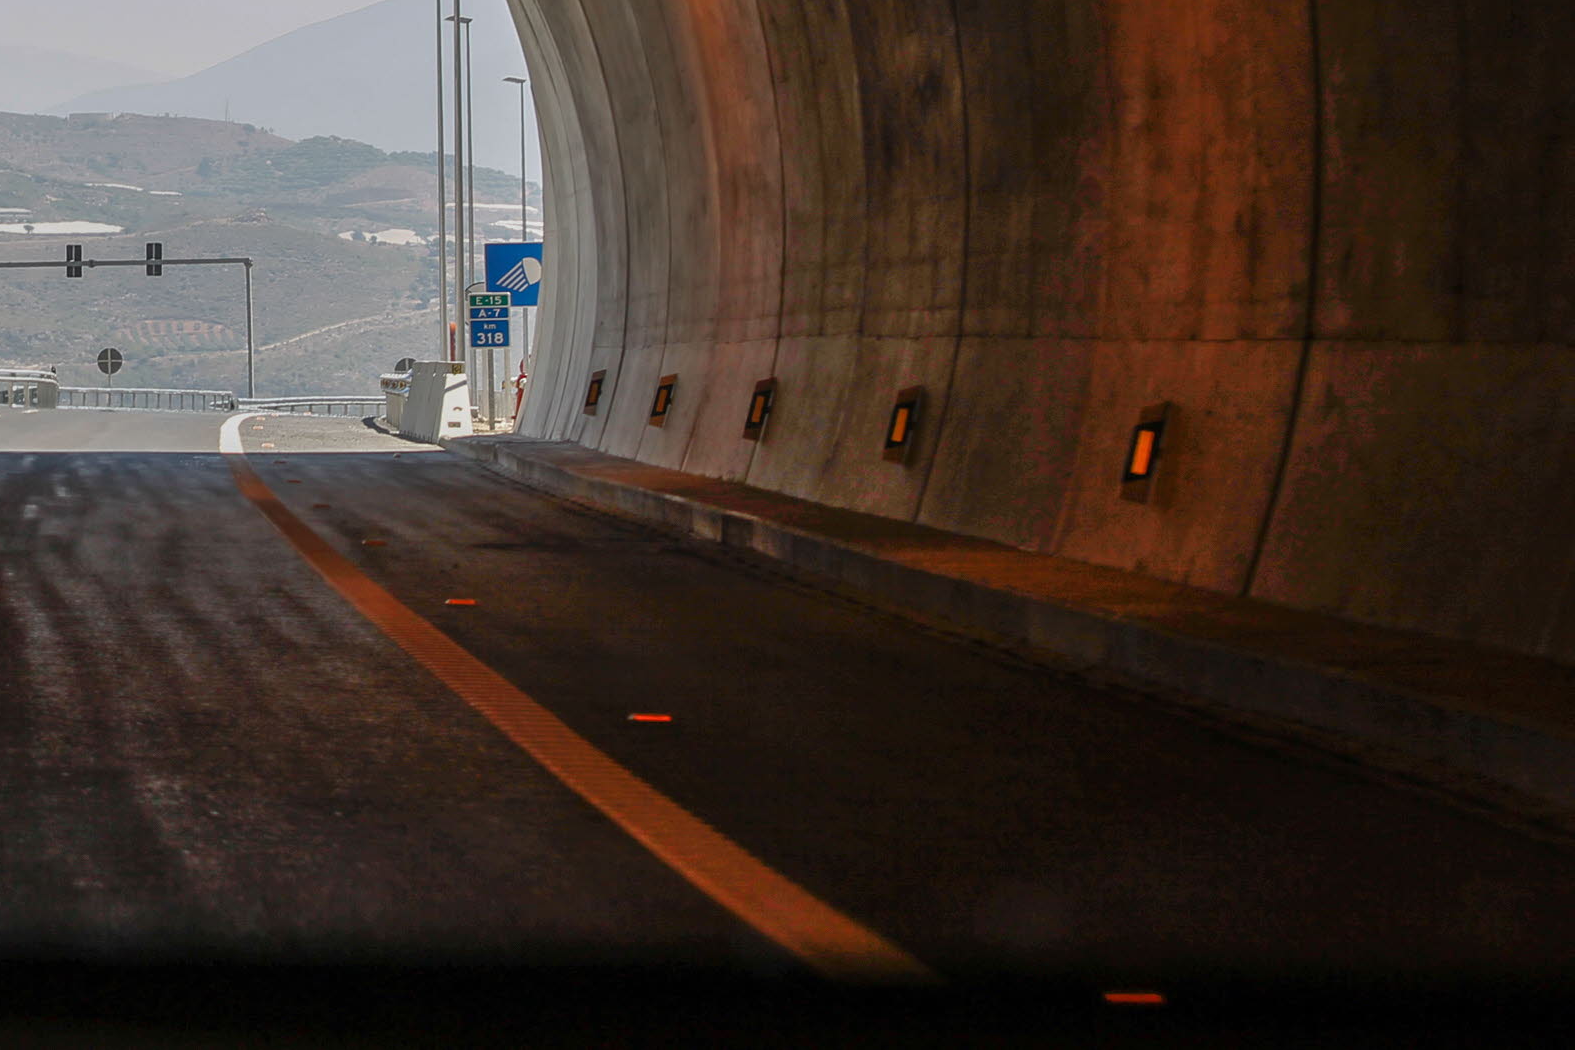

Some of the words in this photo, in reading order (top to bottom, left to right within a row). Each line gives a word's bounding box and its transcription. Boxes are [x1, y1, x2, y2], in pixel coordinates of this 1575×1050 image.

[475, 296, 502, 305] E-15
[478, 309, 501, 318] A-7
[476, 333, 504, 344] 318
